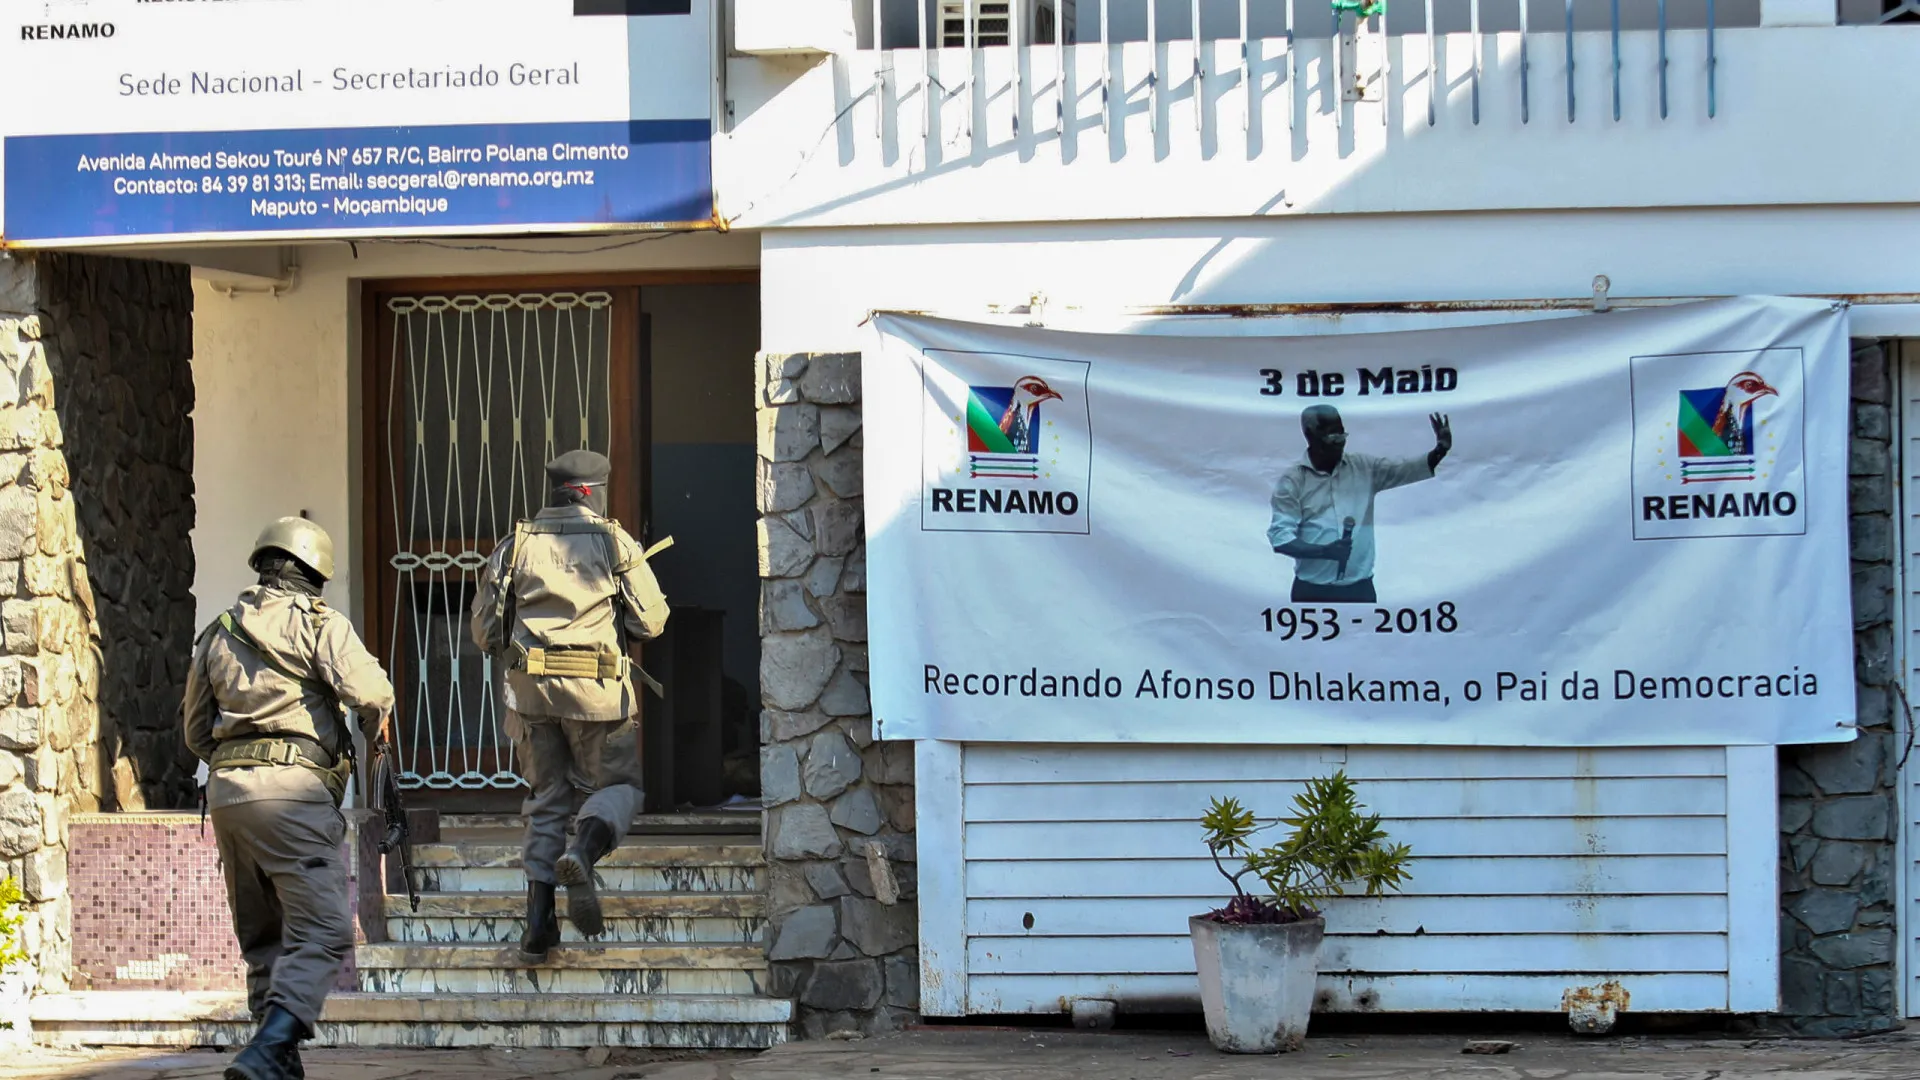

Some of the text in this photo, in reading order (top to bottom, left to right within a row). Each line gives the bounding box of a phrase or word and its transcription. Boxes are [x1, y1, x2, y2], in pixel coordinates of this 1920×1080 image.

[21, 22, 115, 40] RENAMO
[119, 72, 181, 96] Sede
[191, 68, 303, 94] Nacional
[332, 64, 499, 91] Secretariado
[509, 61, 580, 86] Geral
[77, 153, 146, 172] Avenida
[149, 151, 212, 170] Ahmed
[215, 151, 270, 168] Sekou
[273, 149, 322, 166] Touré
[351, 147, 382, 165] 657
[386, 146, 424, 166] R/C,
[428, 145, 482, 163] Bairro
[486, 144, 548, 162] Polana
[552, 143, 629, 161] Cimento
[113, 170, 595, 195] Contacto: 84 39 81 313; Email: secgeral@renamo.org.mz
[251, 198, 318, 219] Maputo
[333, 195, 449, 217] Moçambique
[1258, 365, 1458, 397] 3 de Maio
[931, 488, 1079, 516] RENAMO
[1642, 491, 1797, 521] RENAMO
[1260, 607, 1341, 641] 1953
[1374, 600, 1459, 634] 2018
[923, 664, 1818, 707] Recordando Afonso Dhlakama, o Pai da Democracia
